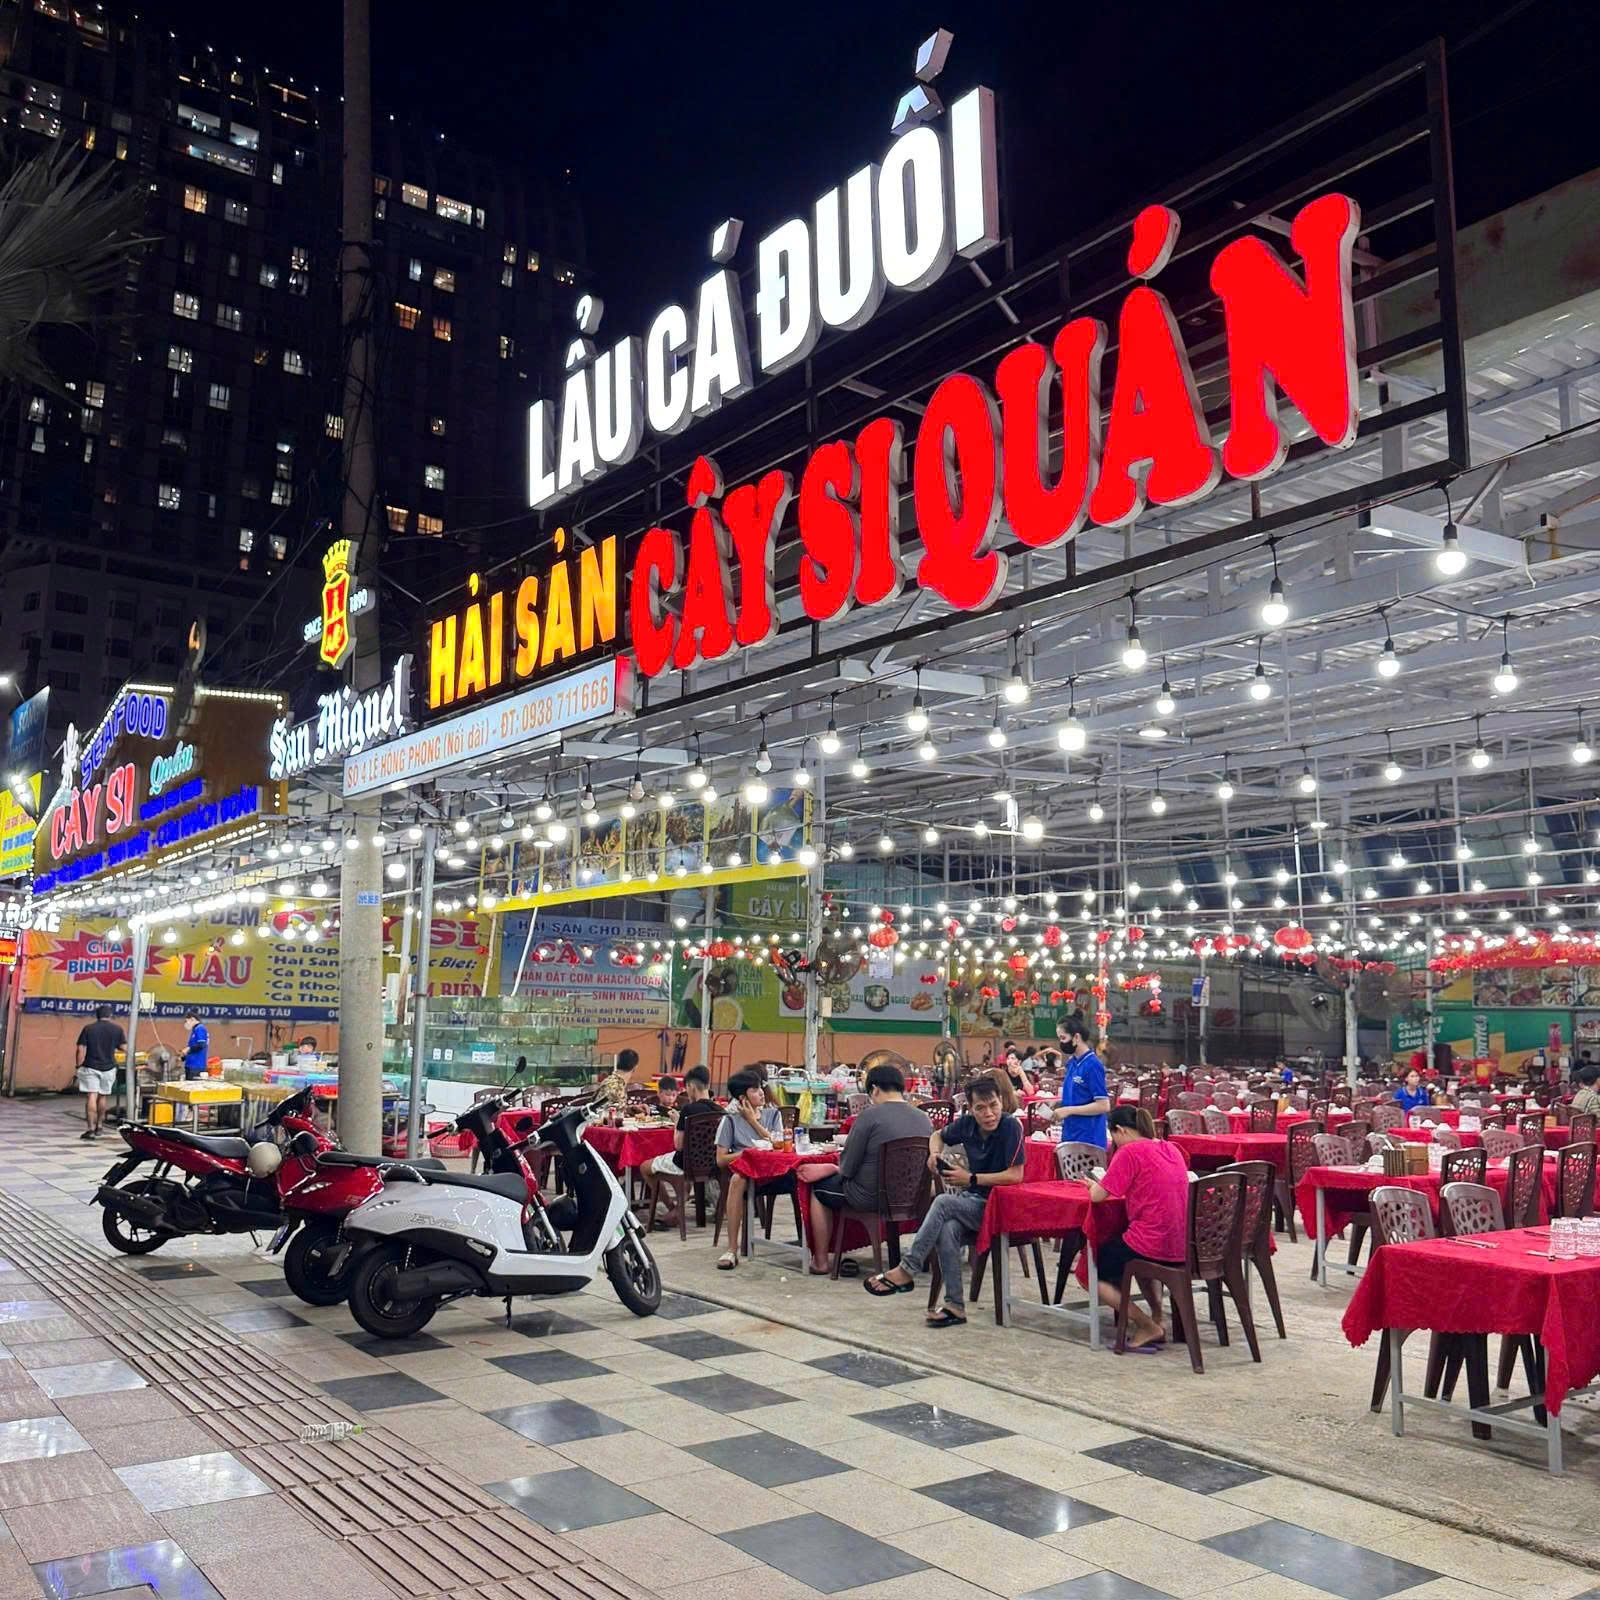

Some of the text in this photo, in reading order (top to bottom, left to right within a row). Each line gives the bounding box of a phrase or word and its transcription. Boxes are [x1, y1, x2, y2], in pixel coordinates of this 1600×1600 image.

[528, 28, 994, 509] LẨU CÁ ĐUỐI
[630, 193, 1356, 677] CÂY SI QUÁN
[304, 616, 322, 641] SINCE
[429, 527, 616, 710] HẢI SẢN
[81, 692, 167, 789] SEAFOOD
[268, 654, 406, 780] San Miguel
[408, 735, 441, 769] PHONG
[51, 786, 102, 860] CÂY
[106, 763, 136, 834] SI
[150, 740, 194, 795] Quán
[182, 936, 253, 985] LẨU
